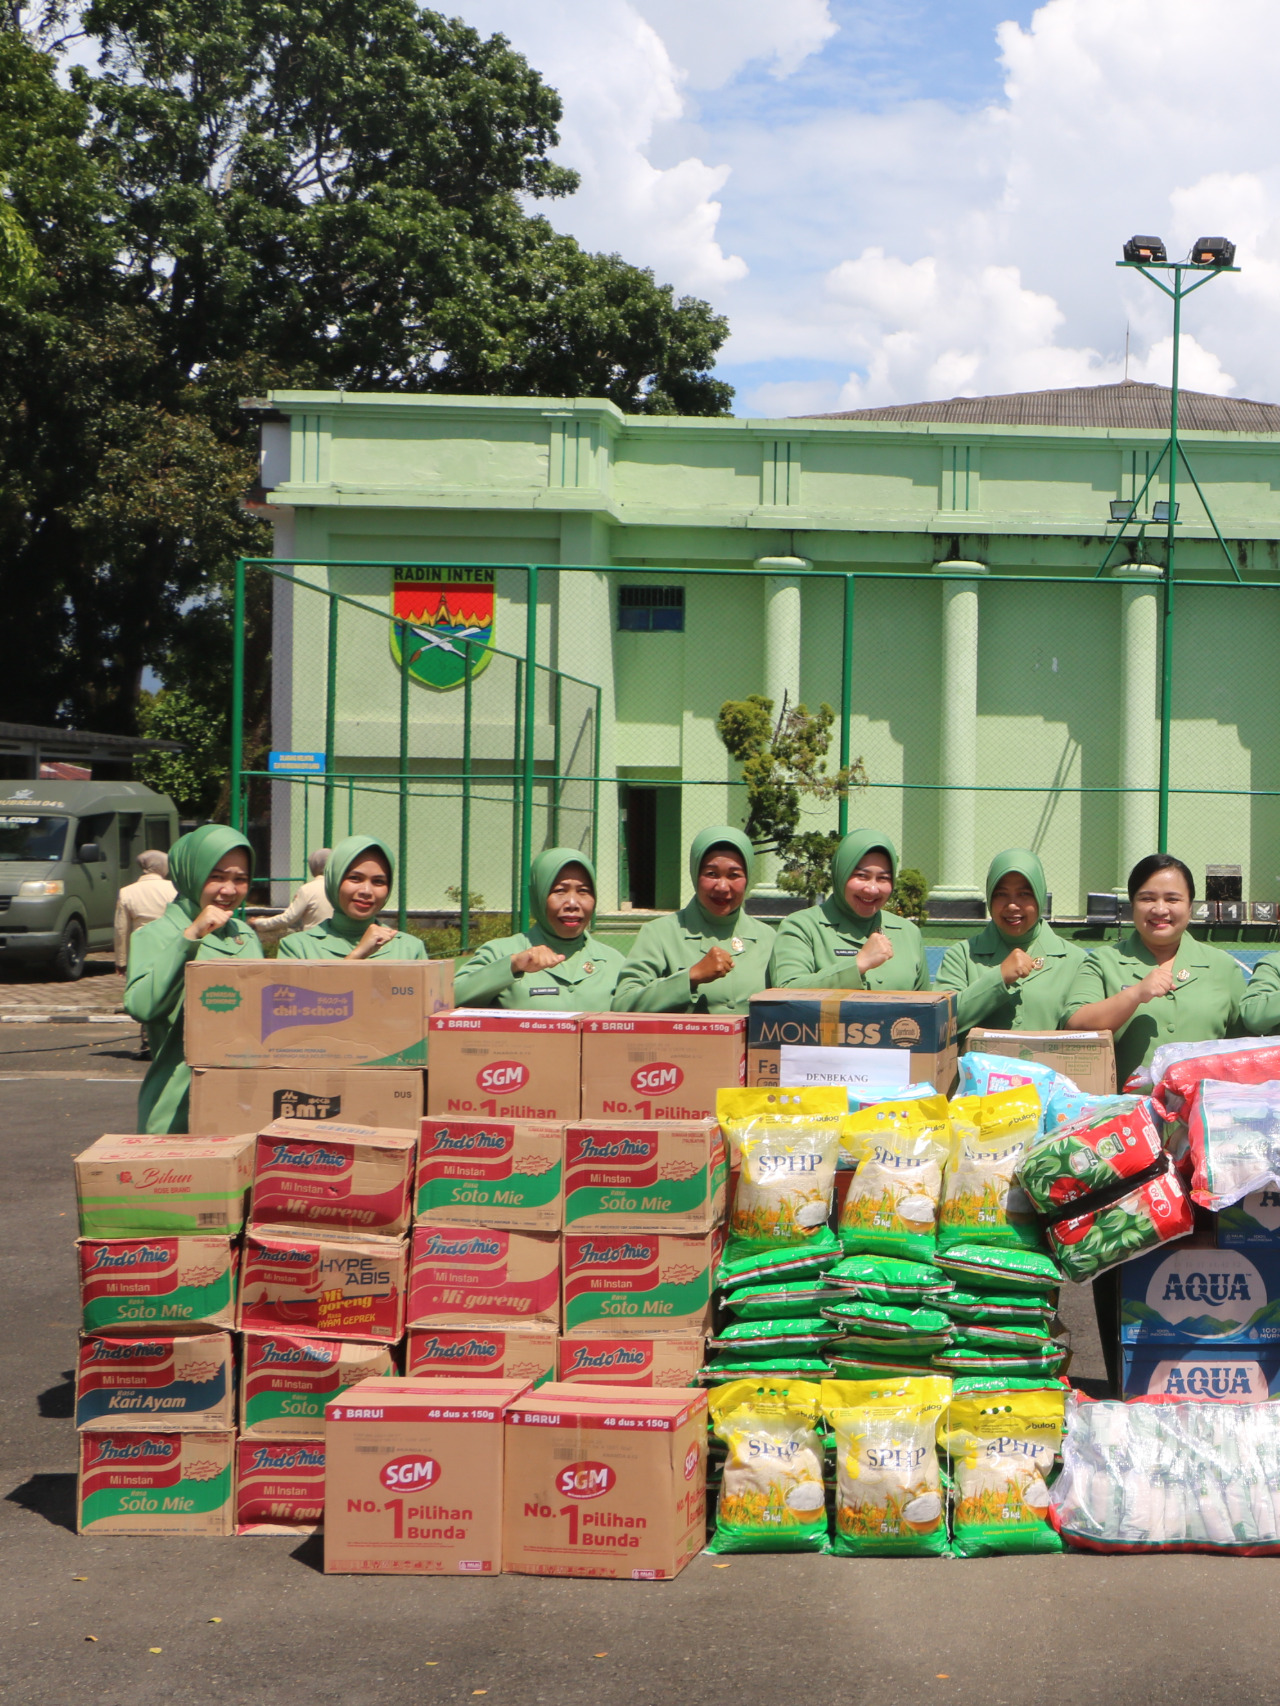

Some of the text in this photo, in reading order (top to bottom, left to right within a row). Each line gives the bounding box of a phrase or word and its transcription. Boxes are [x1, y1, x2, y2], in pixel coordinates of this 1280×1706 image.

[394, 567, 494, 582] RADIN INTEN
[1196, 903, 1237, 919] 4 1
[391, 986, 415, 996] DUS
[448, 1020, 481, 1028] BARU!
[556, 1022, 577, 1031] 150g
[602, 1022, 634, 1030] BARU!
[710, 1024, 730, 1033] 150g
[759, 1021, 881, 1045] MONTISS
[481, 1067, 523, 1086] SGM
[636, 1068, 677, 1088] SGM
[806, 1073, 868, 1082] DENBEKANG
[394, 1091, 412, 1099] DUS
[280, 1103, 330, 1118] BMT
[448, 1099, 556, 1119] No. 1 Pilihan
[602, 1101, 711, 1119] No. 1 Pilihan
[1013, 1113, 1036, 1125] bulog
[759, 1154, 823, 1172] SPHP
[135, 1167, 193, 1189] Bihun
[444, 1166, 485, 1176] Mi Instan
[590, 1174, 631, 1183] Mi Instan
[281, 1182, 323, 1194] Mi Instan
[451, 1188, 524, 1205] Soto Mie
[599, 1196, 672, 1211] Soto Mie
[308, 1204, 376, 1223] goreng
[873, 1215, 880, 1225] 5
[978, 1211, 985, 1221] 5
[773, 1227, 780, 1236] 5
[320, 1258, 377, 1273] HYPE
[273, 1274, 297, 1283] Instan
[345, 1271, 390, 1286] ABIS
[436, 1274, 479, 1283] Mi Instan
[590, 1279, 632, 1288] Mi Instan
[106, 1283, 150, 1292] Mi Instan
[1162, 1272, 1251, 1306] AQUA
[318, 1296, 373, 1315] goreng
[463, 1294, 532, 1312] goreng
[600, 1300, 674, 1315] Soto Mie
[117, 1304, 193, 1319] Soto Mie
[343, 1313, 376, 1325] GEPREK
[102, 1375, 147, 1384] Mi Instan
[272, 1379, 313, 1389] Mi Instan
[1164, 1366, 1253, 1398] AQUA
[108, 1395, 187, 1412] Kari Ayam
[280, 1400, 318, 1415] Soto
[346, 1409, 384, 1418] BARU!
[428, 1410, 495, 1420] 48 dus 150g
[524, 1414, 560, 1424] BARU!
[604, 1418, 670, 1429] 48 dus 150g
[1031, 1422, 1056, 1430] bulog
[986, 1437, 1045, 1458] SPHP
[685, 1448, 699, 1476] SGM
[866, 1447, 926, 1467] SPHP
[110, 1475, 153, 1485] Mi Instan
[386, 1461, 433, 1485] SGM
[561, 1468, 608, 1491] SGM
[264, 1486, 307, 1496] Mi Instan
[118, 1496, 194, 1511] Soto Mie
[347, 1498, 473, 1539] No. 1 Pilihan
[762, 1511, 770, 1521] 5
[1002, 1508, 1009, 1519] 5
[524, 1503, 647, 1545] No. 1 Pilihan
[880, 1523, 888, 1533] 5
[407, 1526, 467, 1540] Bunda
[582, 1533, 641, 1548] Bunda
